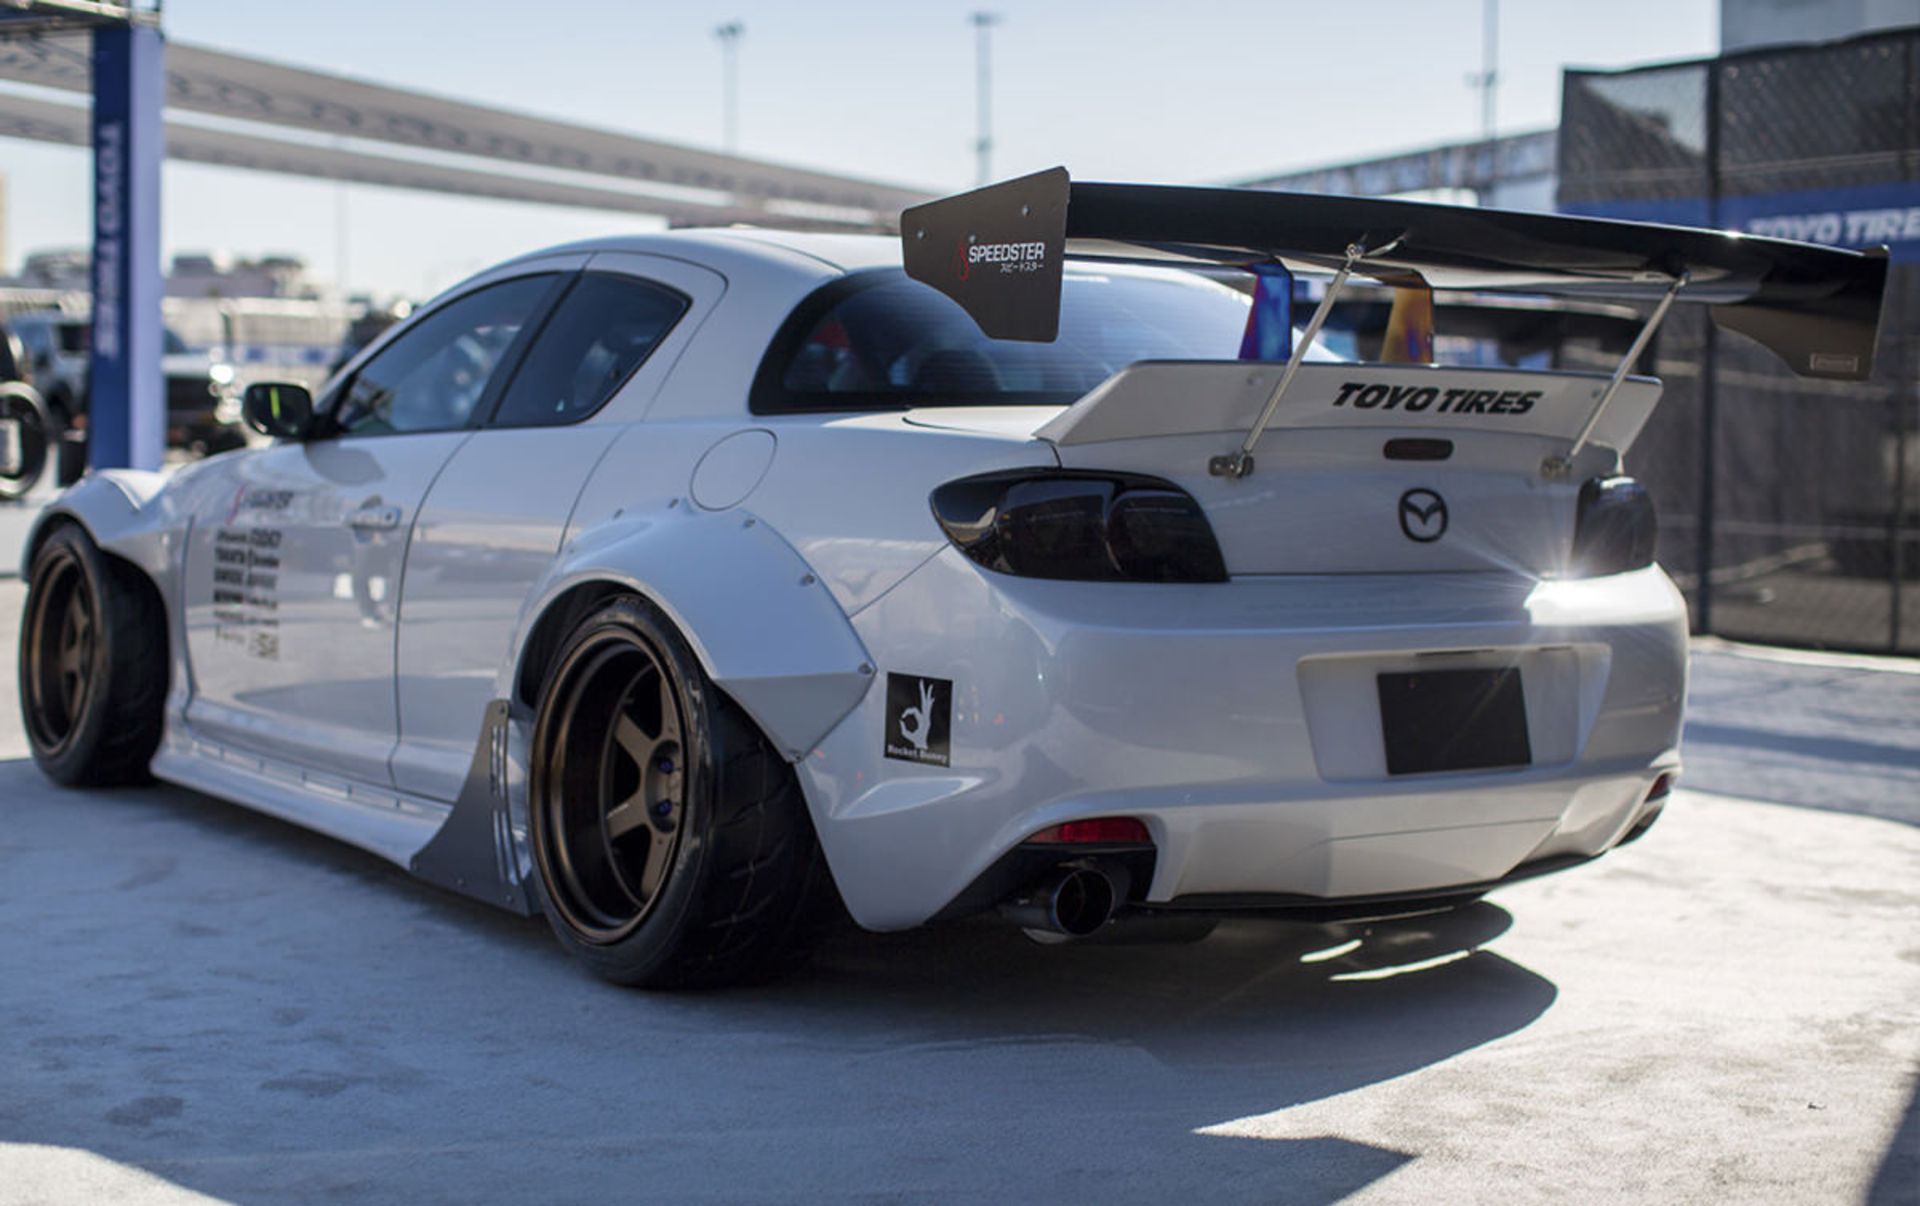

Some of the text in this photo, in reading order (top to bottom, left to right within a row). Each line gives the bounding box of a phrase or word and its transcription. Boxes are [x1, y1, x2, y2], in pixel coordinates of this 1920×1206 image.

[1749, 213, 1842, 244] TOYO
[968, 242, 1045, 263] SPEEDSTER
[1333, 382, 1544, 415] TOYO TIRES
